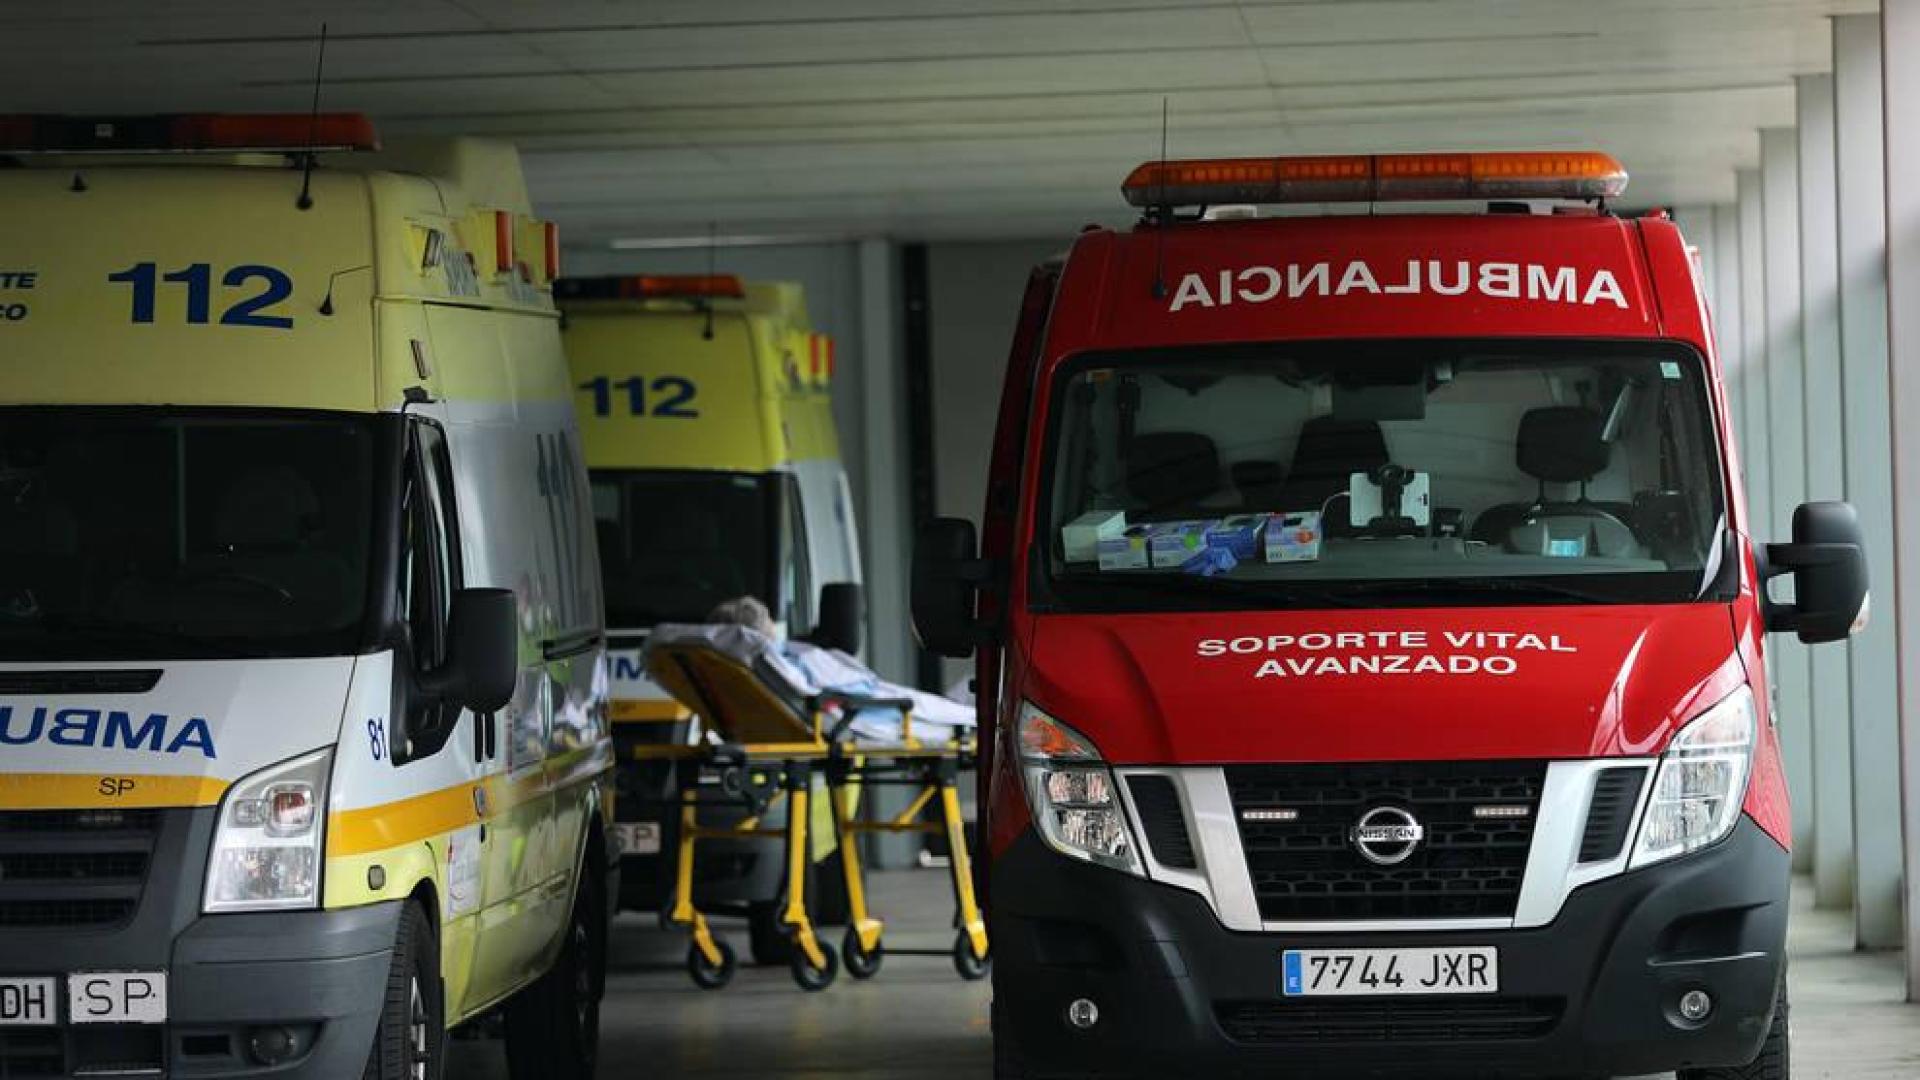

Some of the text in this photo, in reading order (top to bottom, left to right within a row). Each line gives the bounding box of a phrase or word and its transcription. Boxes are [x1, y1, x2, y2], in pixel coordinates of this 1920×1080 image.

[108, 262, 294, 329] 112
[577, 375, 699, 418] 112
[1197, 631, 1577, 656] SOPORTE VITAL
[1254, 655, 1518, 679] AVANZADO
[367, 717, 387, 761] 81
[99, 777, 135, 796] SP
[1358, 829, 1415, 839] NISSAN
[1309, 955, 1405, 989] 7744
[1419, 953, 1489, 988] JXR
[0, 984, 46, 1019] DH
[85, 978, 152, 1016] SP
